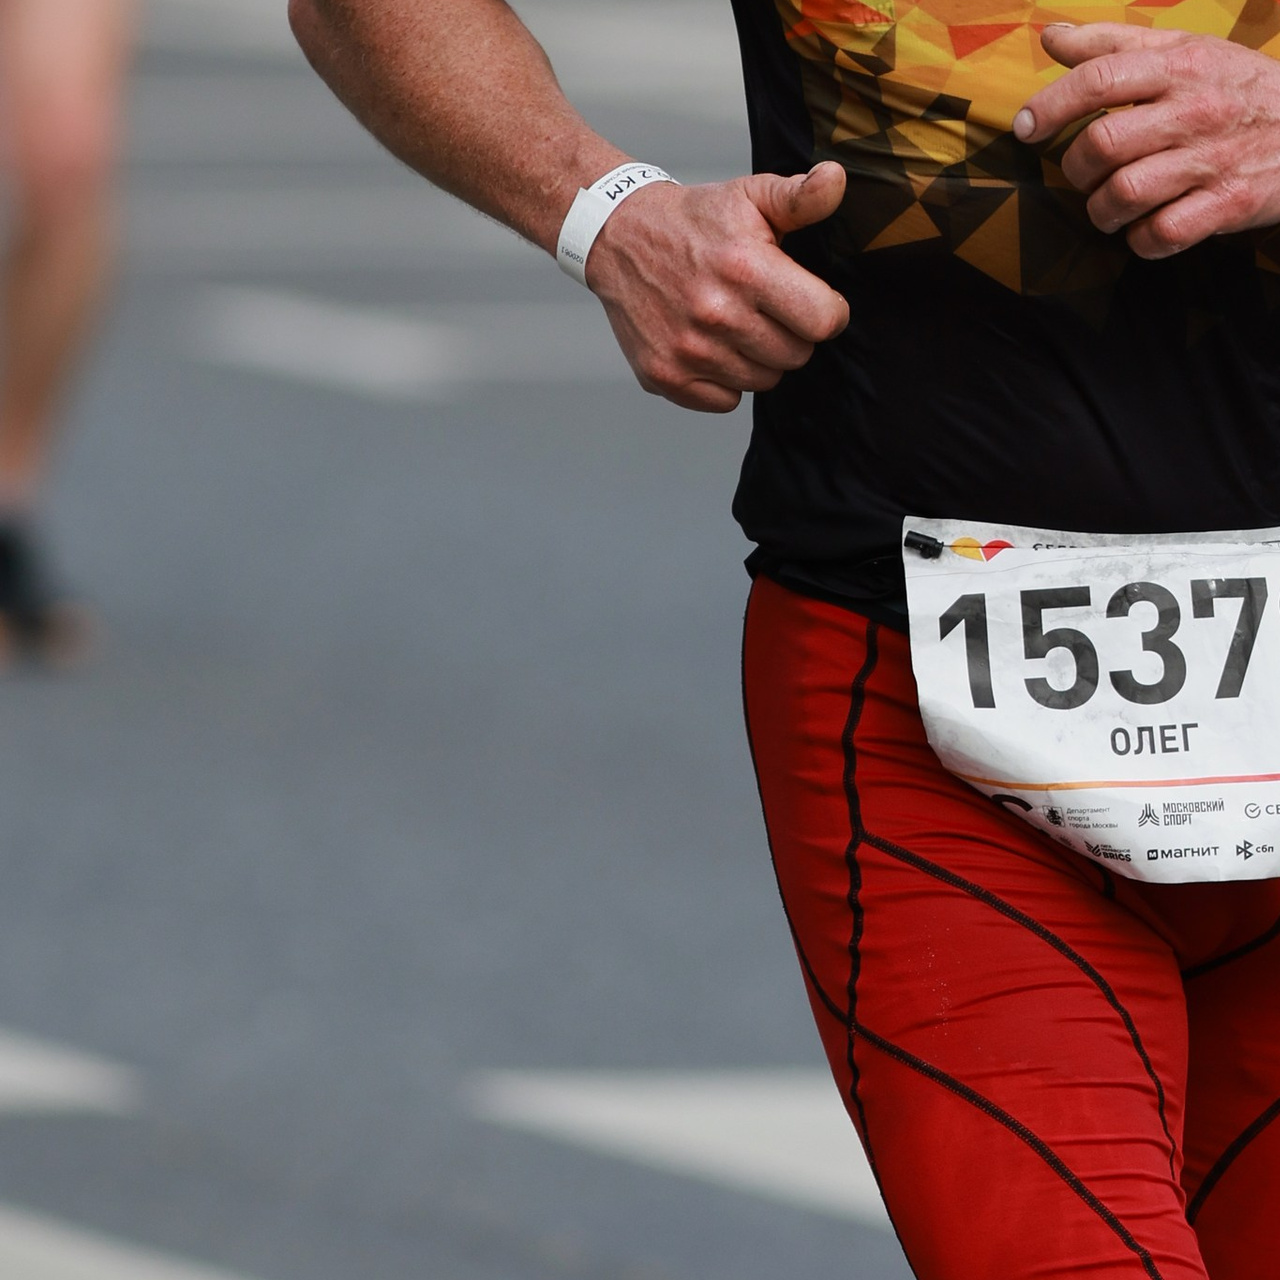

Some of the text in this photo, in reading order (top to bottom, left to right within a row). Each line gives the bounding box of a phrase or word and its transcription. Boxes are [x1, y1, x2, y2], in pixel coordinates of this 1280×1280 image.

[1110, 722, 1199, 756] ОЛЕГ
[1066, 806, 1111, 815] Департамент
[1162, 798, 1225, 813] МОСКОВСКИЙ
[1067, 814, 1090, 822] спорта
[1163, 813, 1193, 826] СПОРТ
[1255, 844, 1274, 853] сбп
[1102, 852, 1132, 862] BRICS
